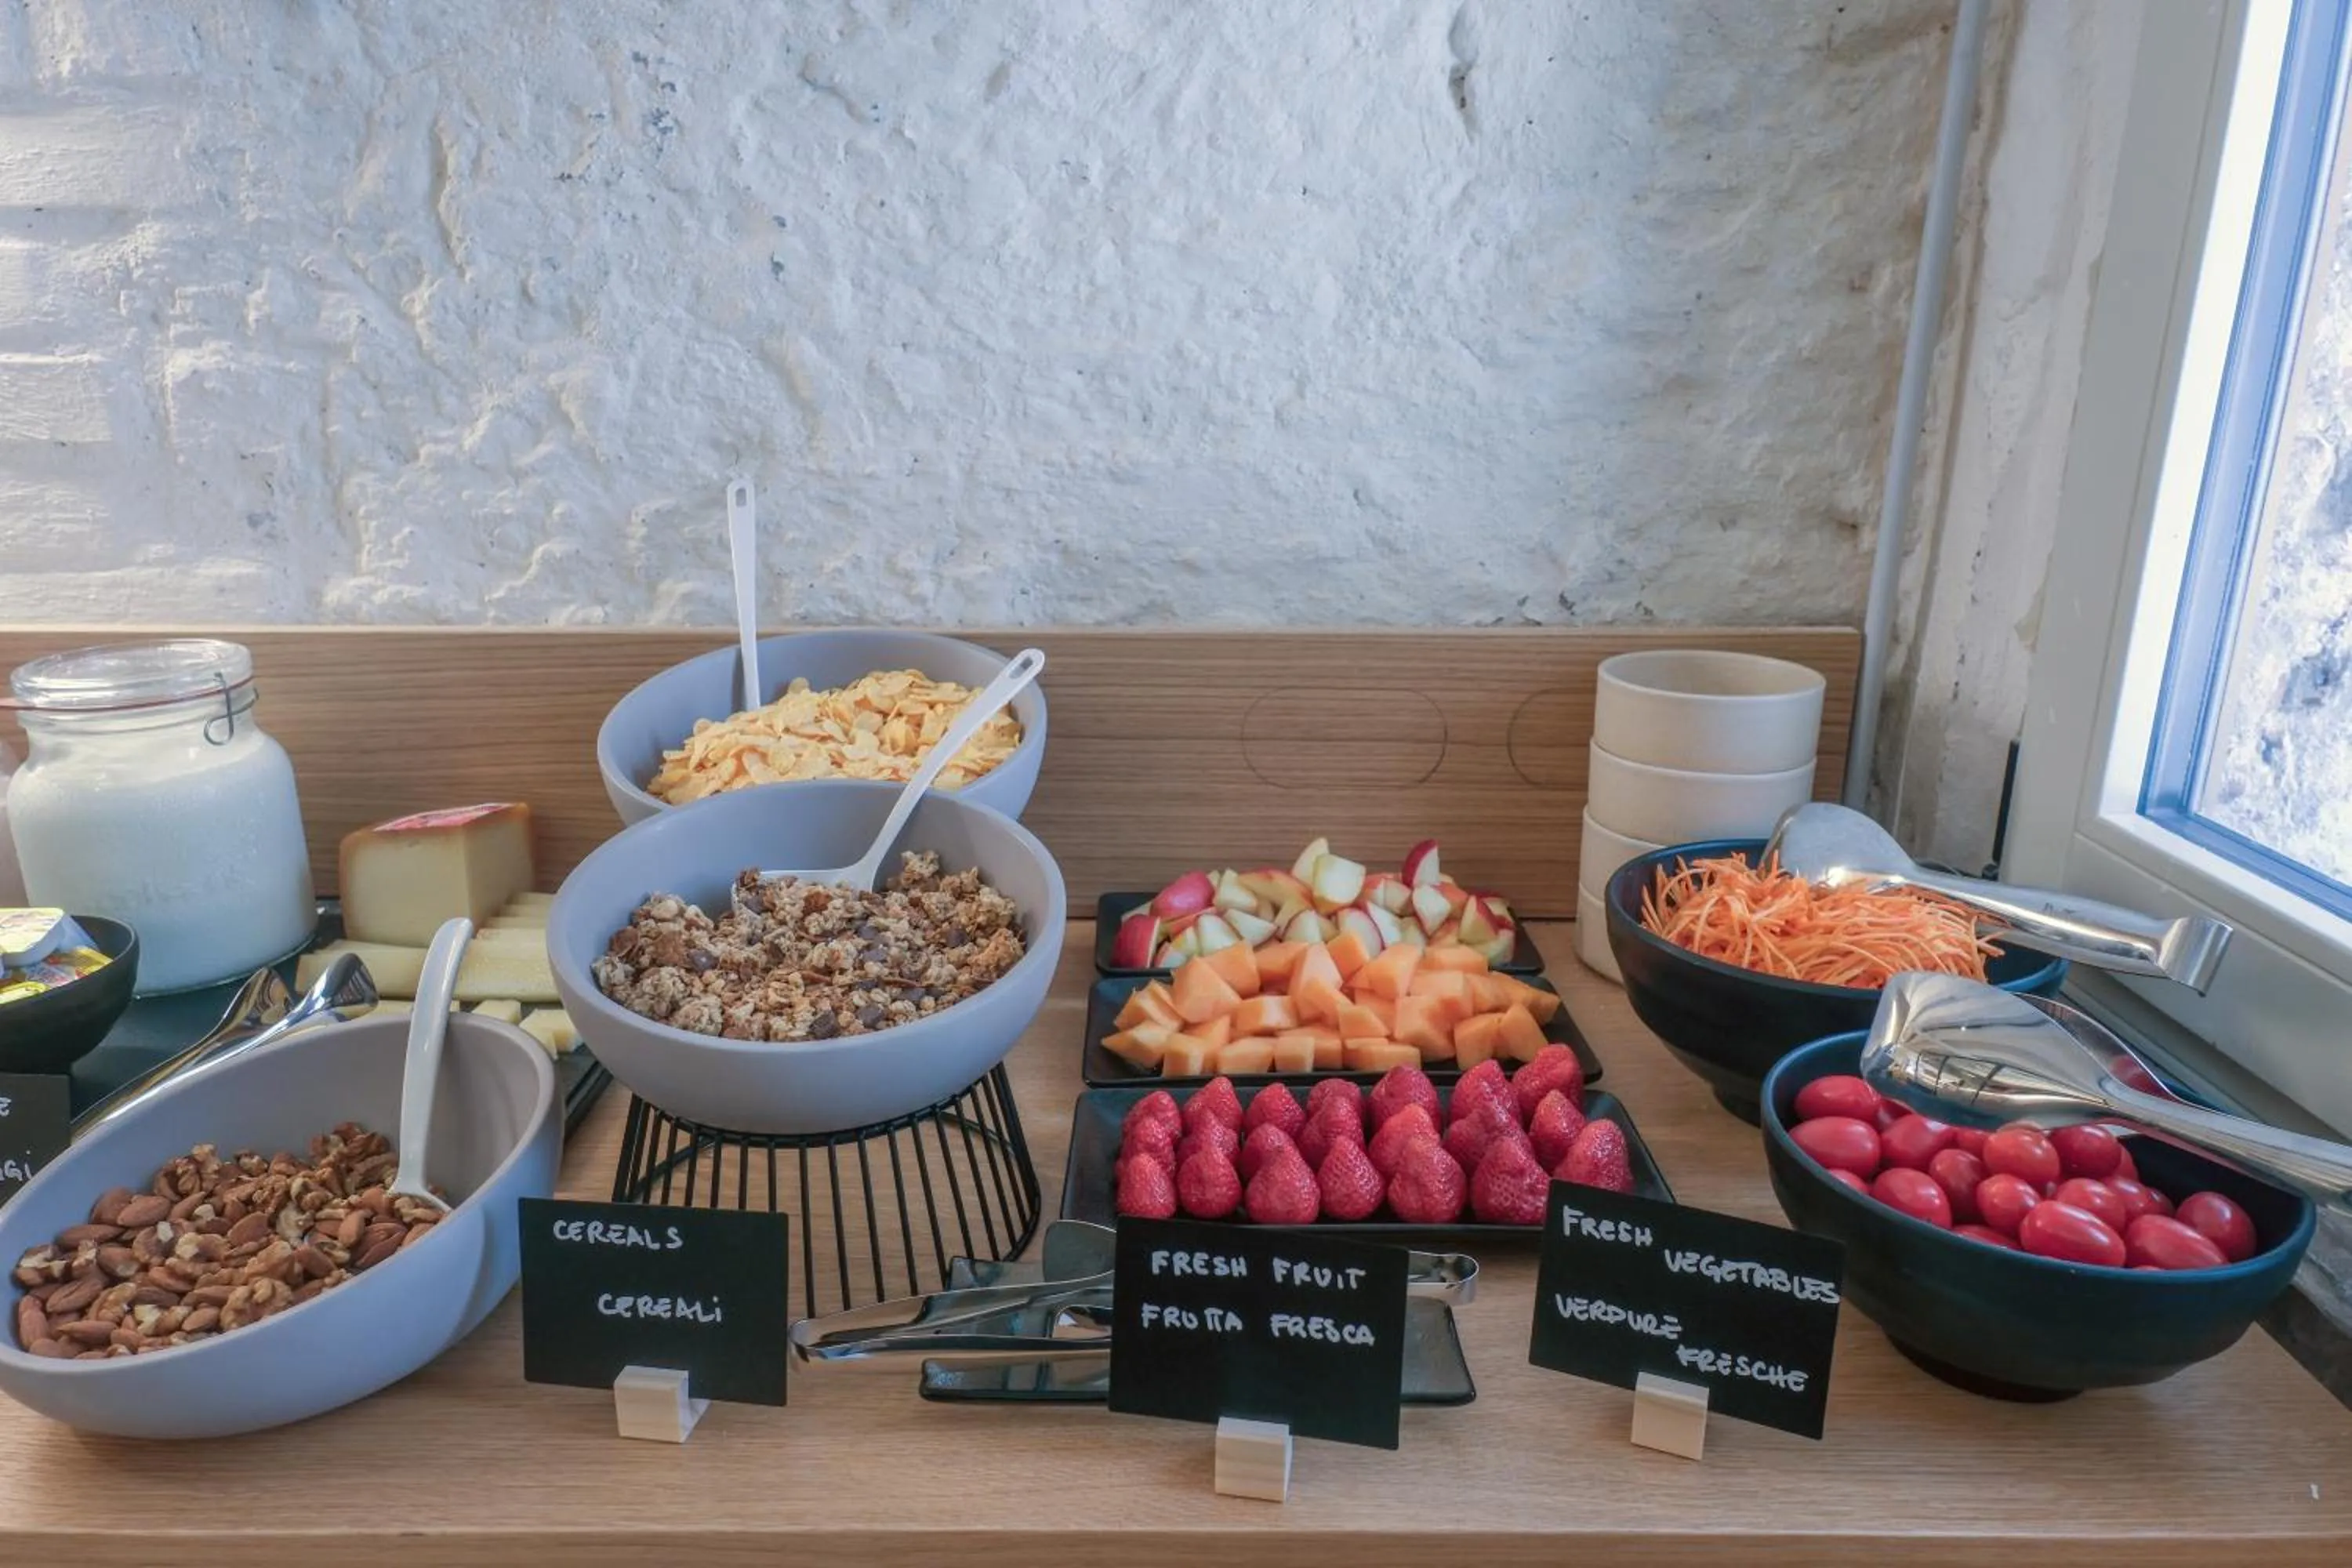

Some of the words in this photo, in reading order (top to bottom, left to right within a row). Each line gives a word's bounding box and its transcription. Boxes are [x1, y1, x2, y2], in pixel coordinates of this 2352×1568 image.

[553, 1219, 684, 1250] CEREALS
[1563, 1205, 1653, 1247] FRESH
[1664, 1248, 1841, 1304] VEGETABLES
[1152, 1250, 1247, 1277] FRESH
[1272, 1258, 1367, 1289] FRUIT
[1141, 1303, 1243, 1332] FRUTTA
[1270, 1314, 1375, 1346] FRESCA
[1555, 1294, 1682, 1340] VERDURE
[1675, 1344, 1809, 1392] FRESCHE
